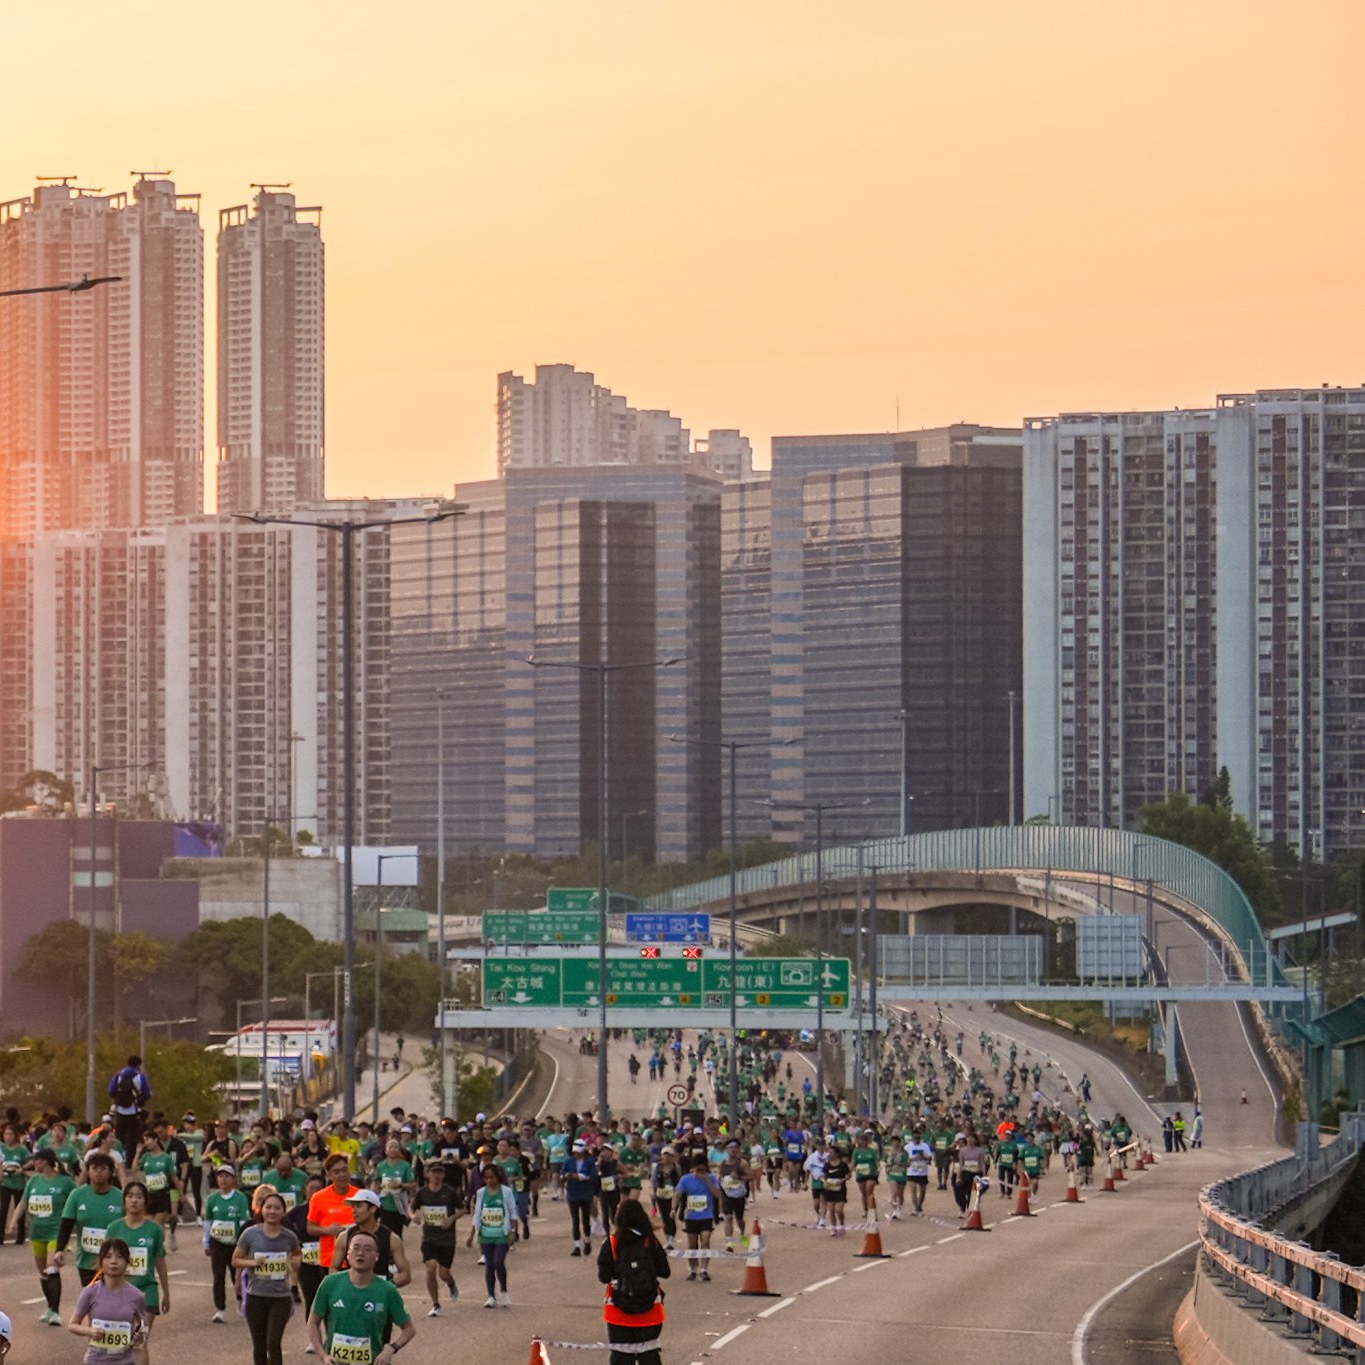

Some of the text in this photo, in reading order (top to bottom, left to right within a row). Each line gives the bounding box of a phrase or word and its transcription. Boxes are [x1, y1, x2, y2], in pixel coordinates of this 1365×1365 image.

[489, 963, 556, 974] Tai Koo Shing
[713, 963, 775, 972] Kowoon (E)
[501, 976, 543, 989] 太古城
[671, 1091, 686, 1100] 70
[303, 1251, 319, 1261] K11
[96, 1333, 130, 1347] 1693
[333, 1346, 371, 1362] K2125
